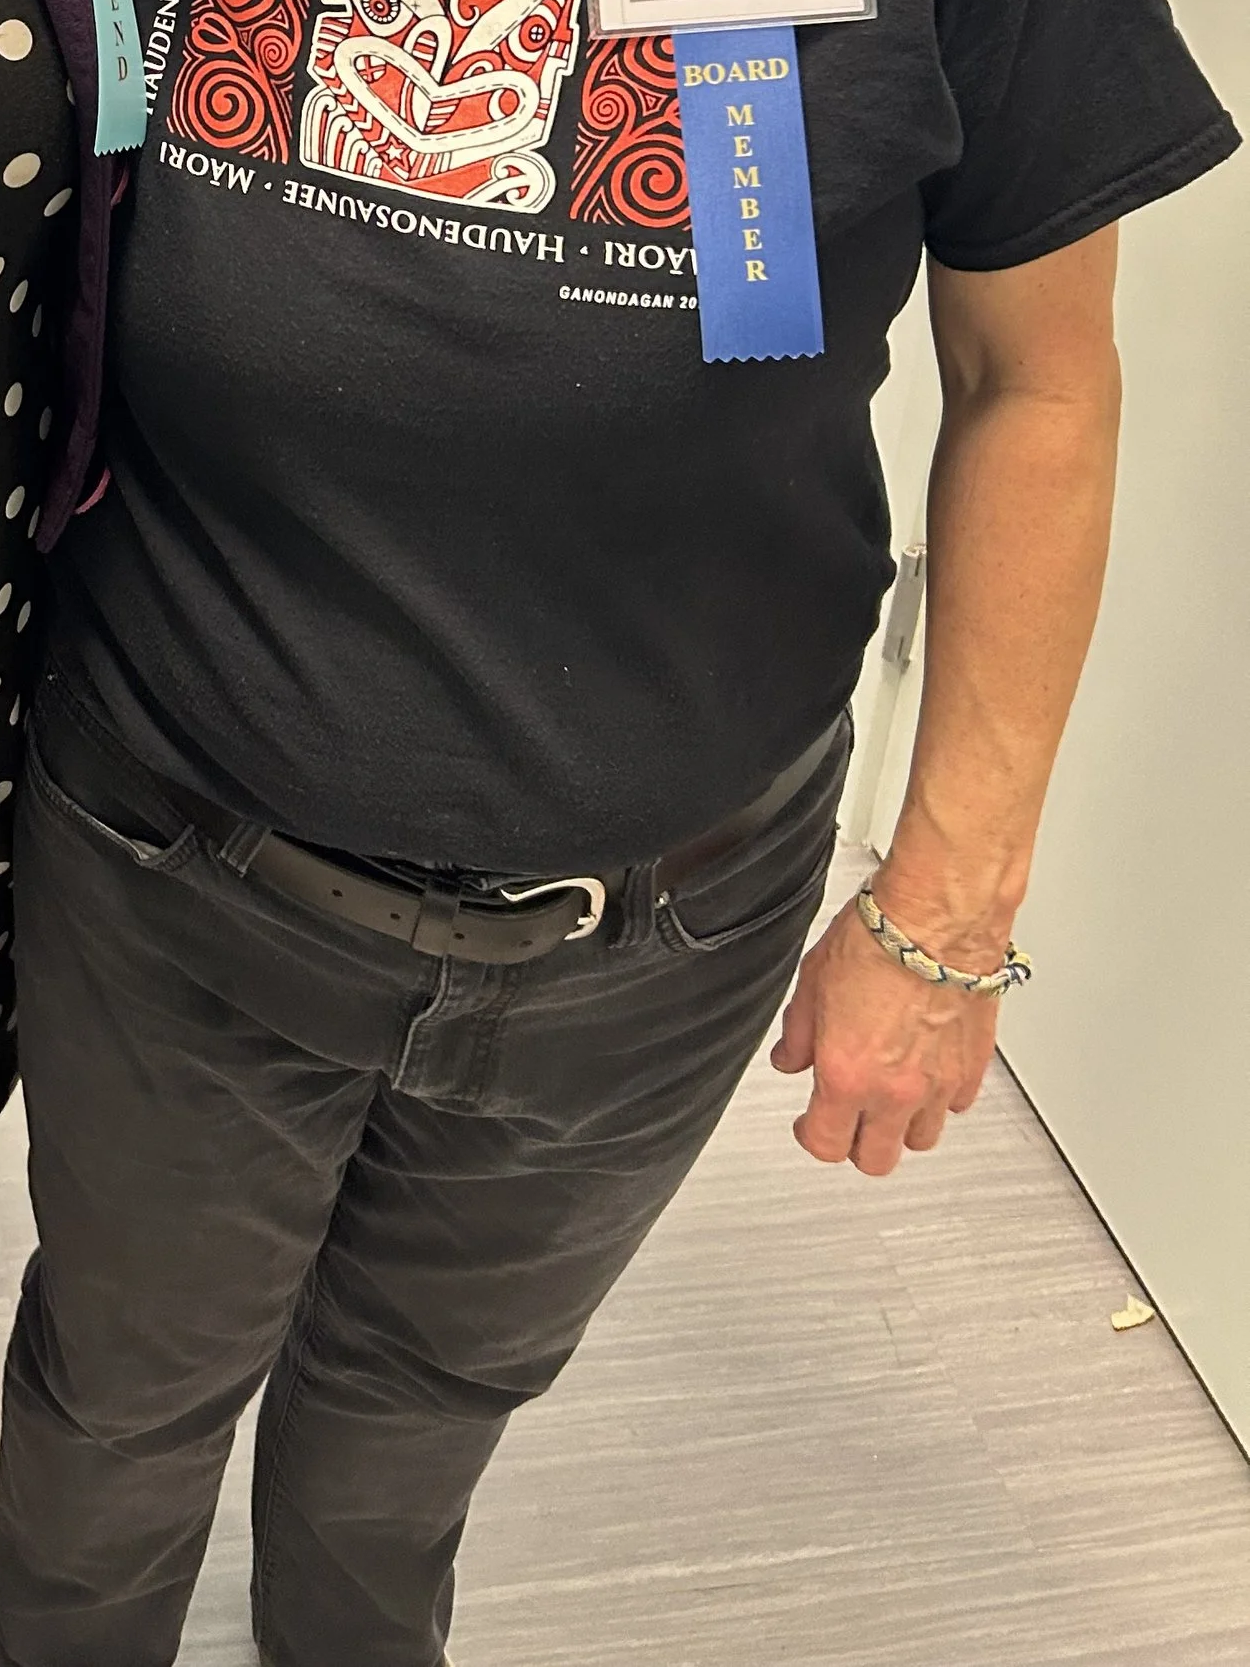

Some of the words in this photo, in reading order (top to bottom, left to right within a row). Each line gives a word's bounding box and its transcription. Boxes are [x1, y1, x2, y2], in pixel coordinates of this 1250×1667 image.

[682, 58, 790, 87] BOARD
[159, 141, 257, 194] MĀORI
[725, 104, 769, 282] MEMBER
[282, 179, 565, 263] HAUDENOSAUNEE
[558, 285, 675, 310] GANONDAGAN
